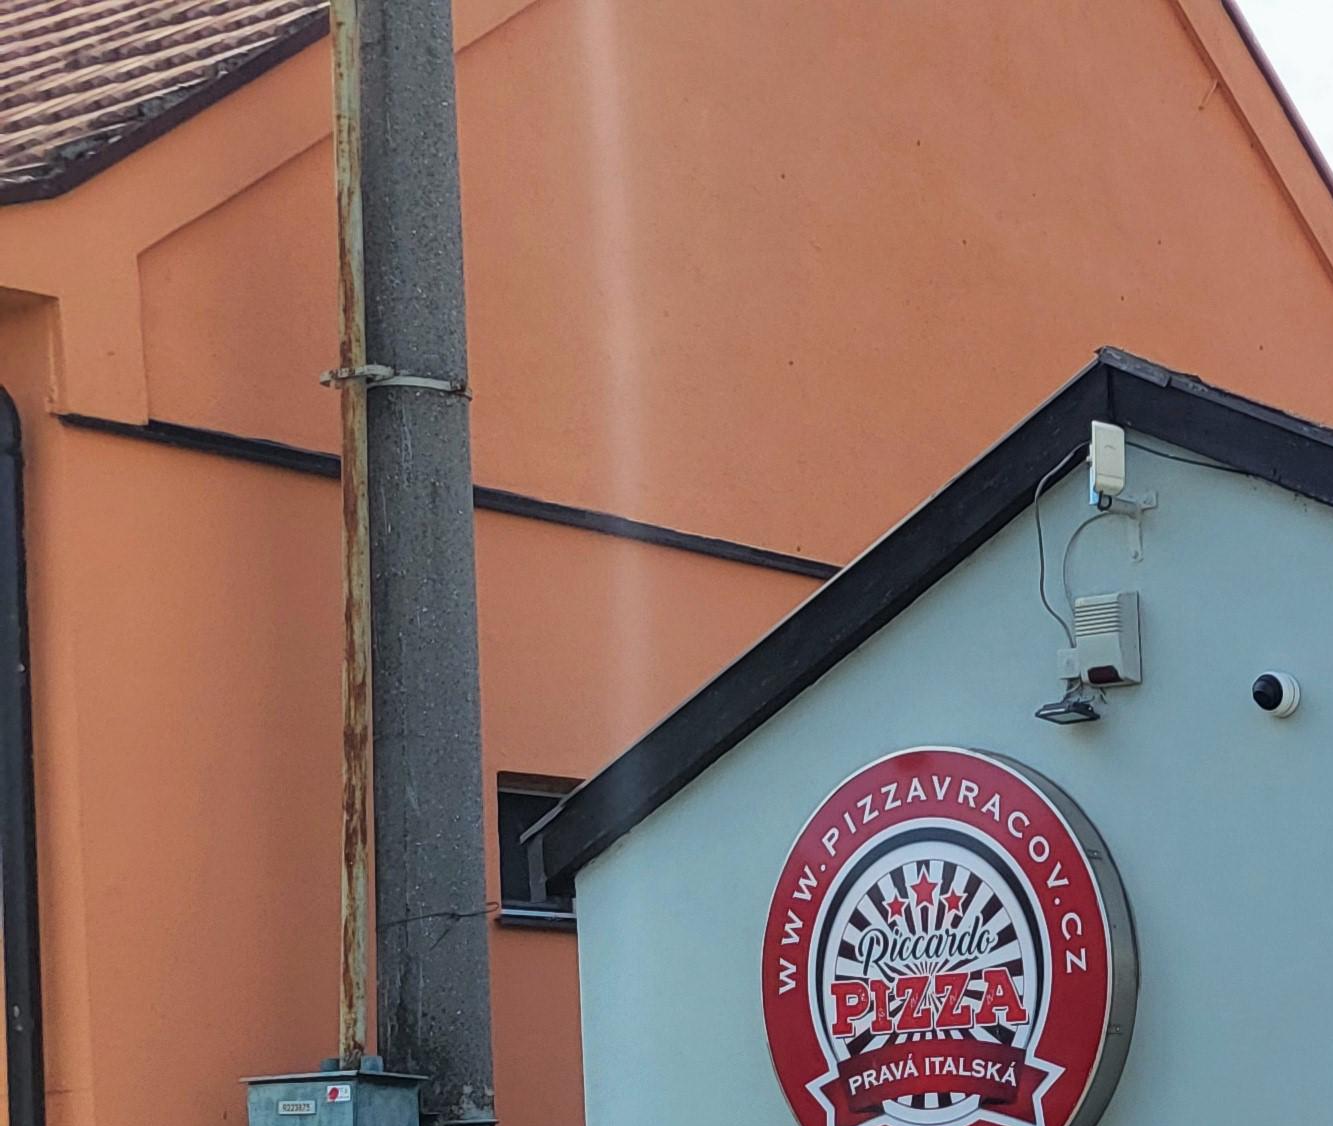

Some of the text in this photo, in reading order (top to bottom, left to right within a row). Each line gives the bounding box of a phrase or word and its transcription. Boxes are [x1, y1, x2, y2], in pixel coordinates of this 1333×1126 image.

[778, 775, 1087, 995] WWW.PIZZAVRACOV.CZ
[857, 914, 998, 982] Riccardo
[830, 968, 1031, 1038] PIZZA
[847, 1057, 1017, 1095] PRAVÁ ITALSKÁ
